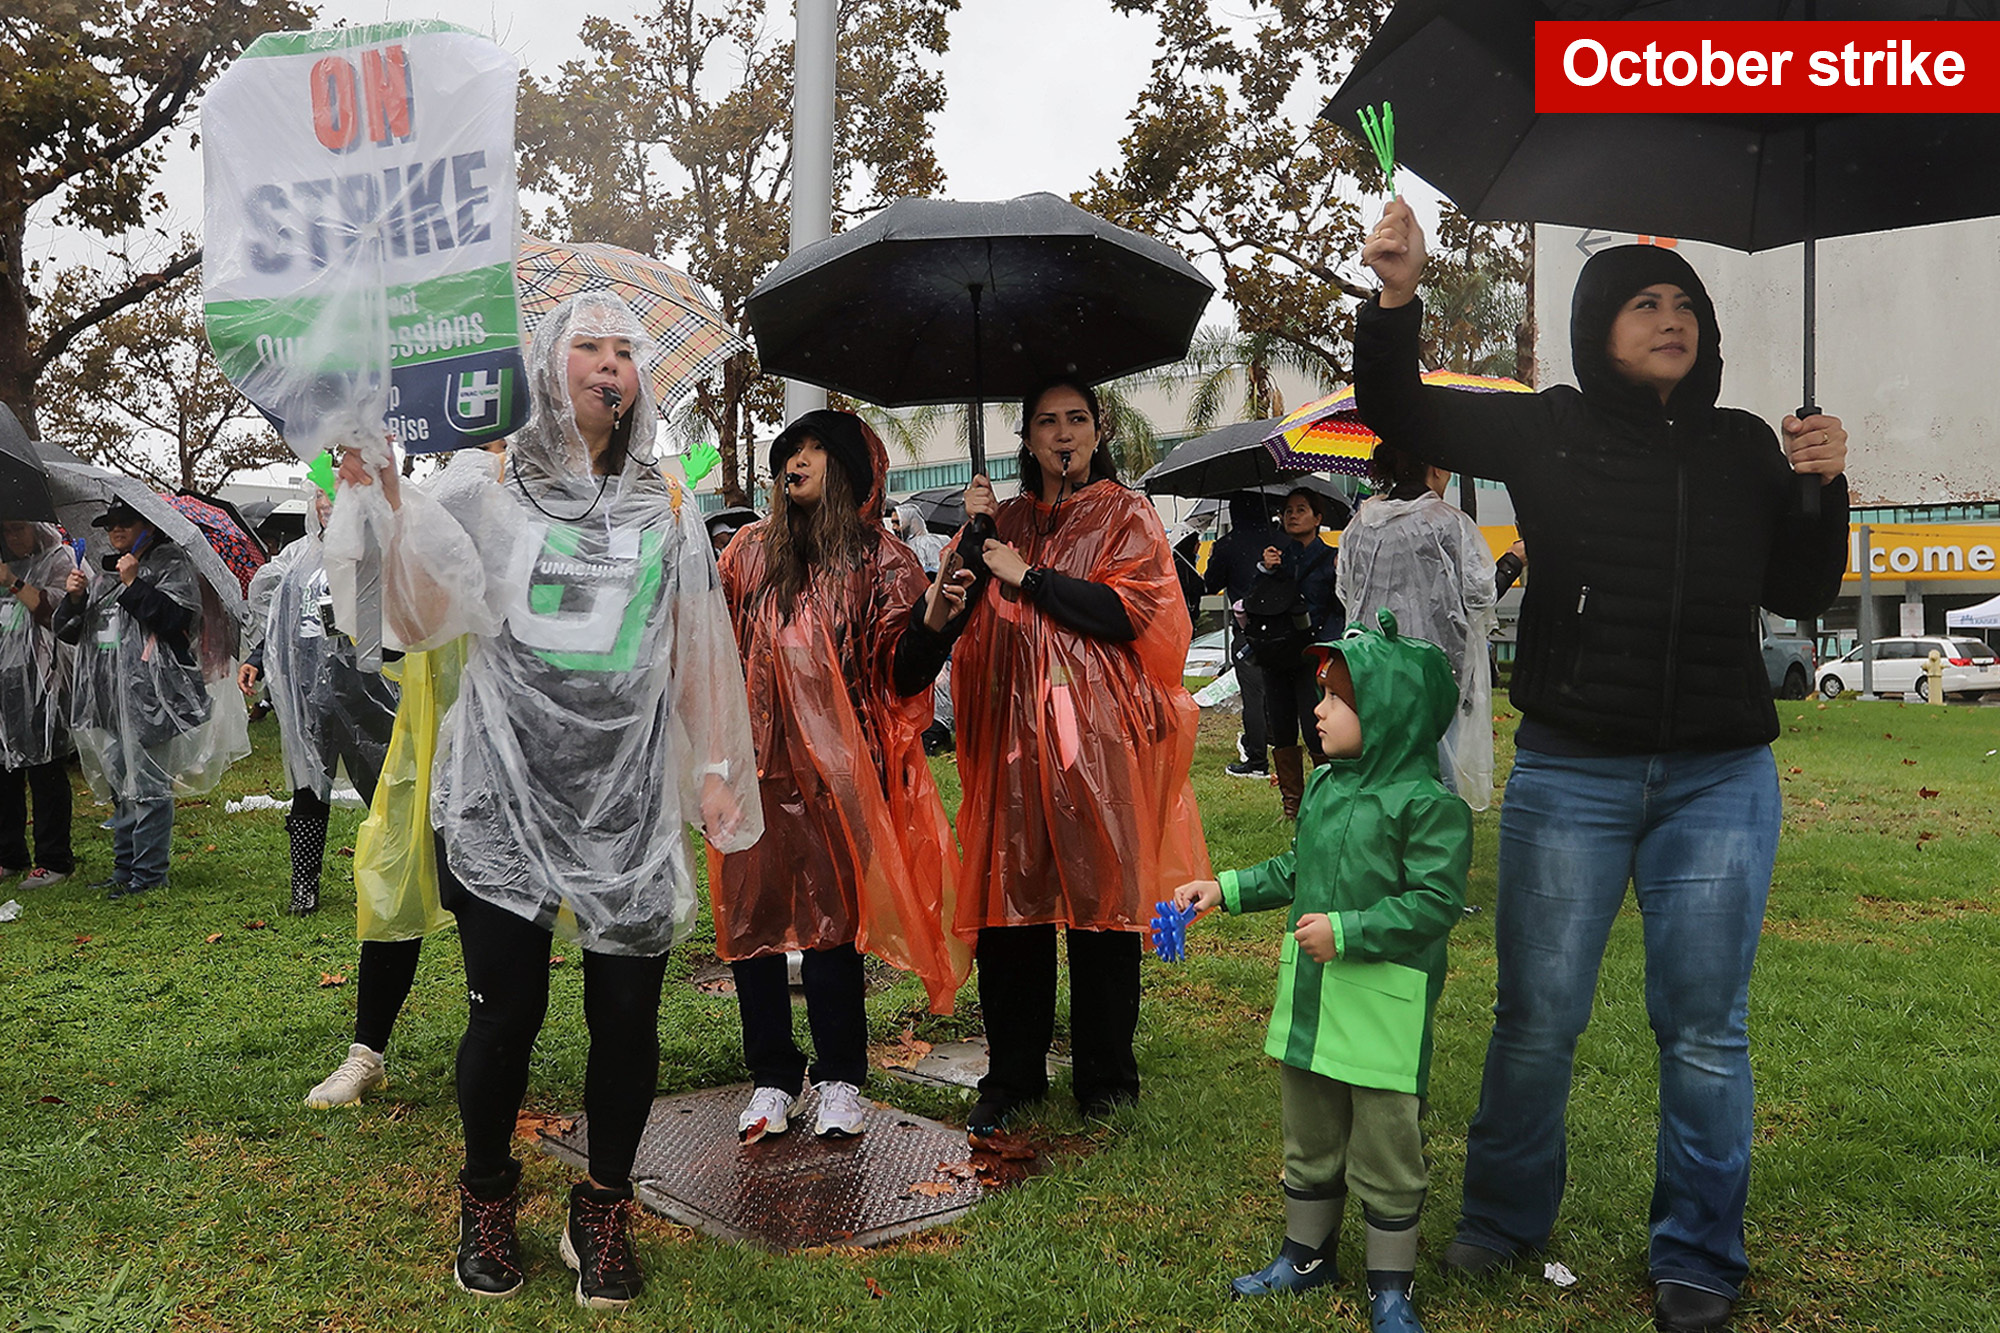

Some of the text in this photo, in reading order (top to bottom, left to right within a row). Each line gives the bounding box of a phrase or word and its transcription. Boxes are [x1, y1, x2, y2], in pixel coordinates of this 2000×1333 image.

[310, 44, 415, 154] ON
[247, 150, 492, 275] STRIKE
[1851, 531, 1996, 573] lcome
